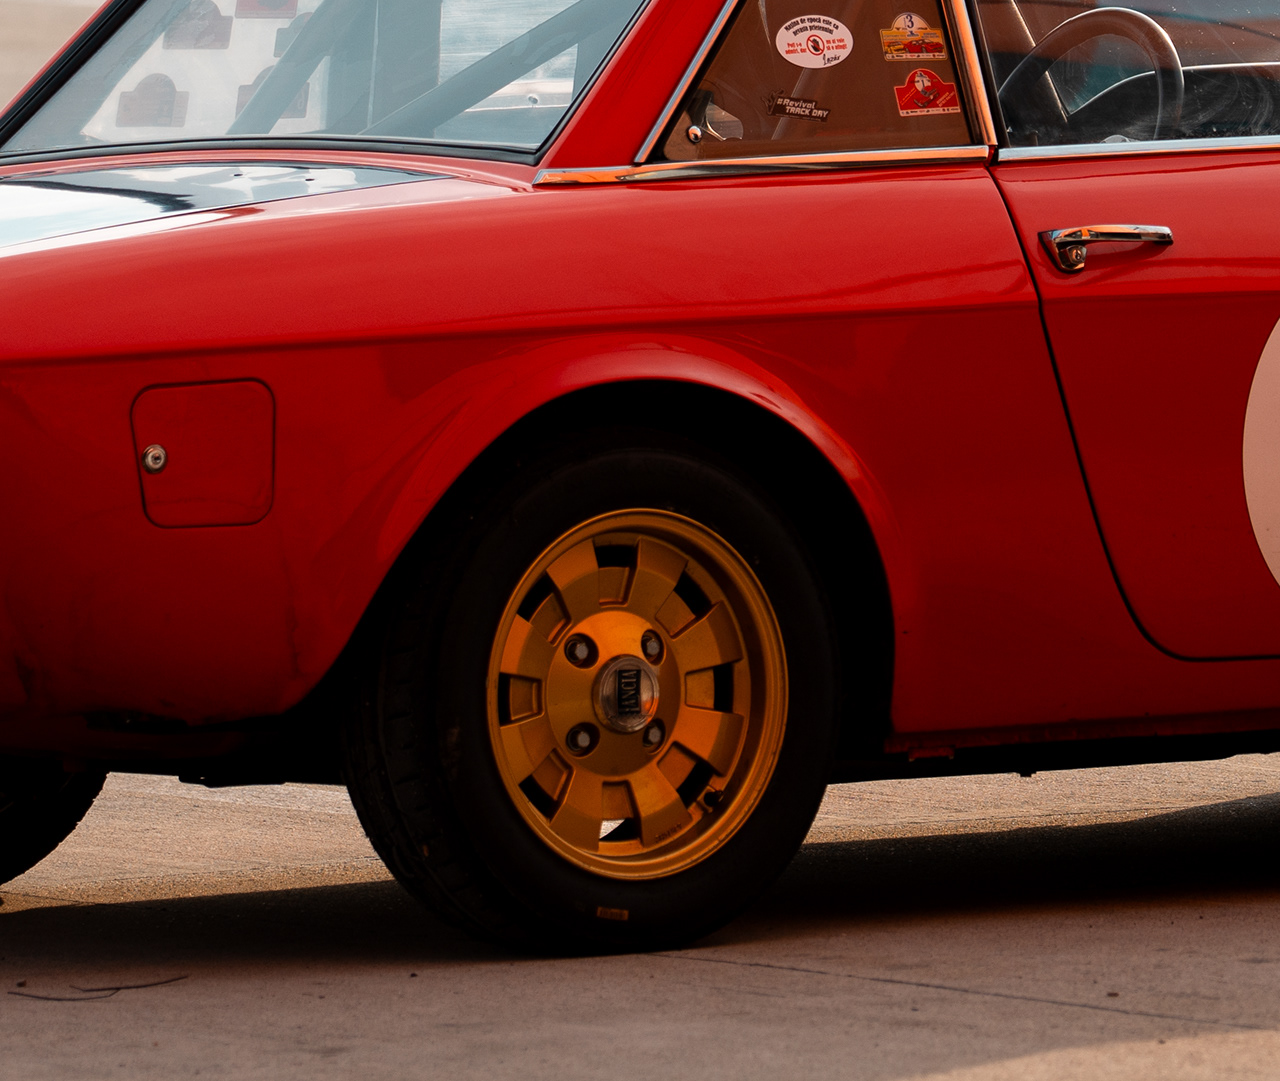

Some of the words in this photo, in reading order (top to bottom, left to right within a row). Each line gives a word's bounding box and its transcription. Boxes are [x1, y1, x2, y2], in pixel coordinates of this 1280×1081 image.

[777, 98, 816, 109] #Revival
[786, 106, 811, 116] TRACK
[811, 109, 829, 118] DAY
